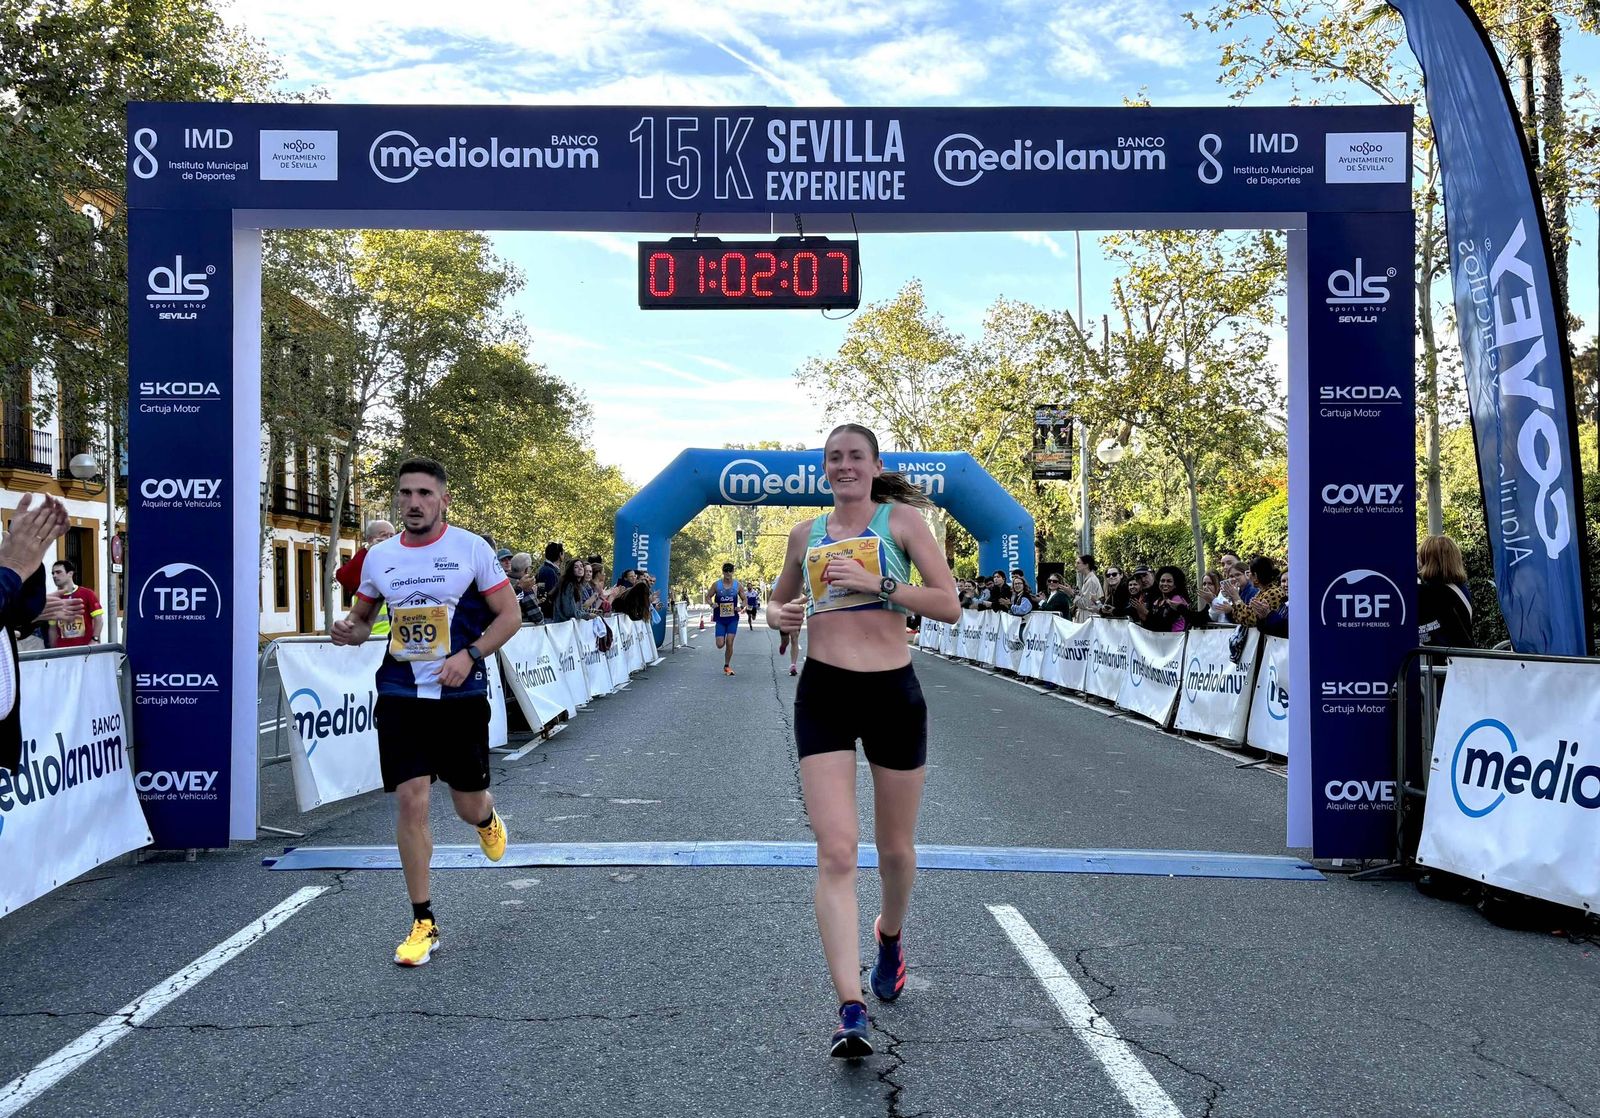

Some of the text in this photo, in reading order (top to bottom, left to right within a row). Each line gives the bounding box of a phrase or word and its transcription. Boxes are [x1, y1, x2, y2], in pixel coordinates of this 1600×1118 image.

[184, 128, 233, 148] IMD
[551, 135, 598, 146] BANCO
[767, 119, 905, 163] SEVILLA
[1117, 136, 1165, 148] BANCO
[1249, 133, 1299, 153] IMD
[380, 137, 599, 168] mediolanum
[945, 139, 1166, 171] mediolanum
[168, 161, 249, 171] Instituto Municipal
[1233, 166, 1314, 175] Instituto Municipal
[182, 172, 236, 181] de Deportes
[1246, 176, 1301, 186] de Deportes
[767, 171, 905, 200] EXPERIENCE
[159, 312, 197, 320] SEVILLA
[1338, 315, 1378, 323] SEVILLA
[140, 404, 200, 414] Cartuja Motor
[1320, 408, 1382, 419] Cartuja Motor
[898, 462, 946, 471] BANCO
[140, 479, 222, 499] COVEY
[1321, 484, 1404, 505] COVEY
[141, 500, 221, 509] Alquiler de Vehículos
[1322, 505, 1404, 515] Alquiler de Vehículos
[392, 577, 445, 587] mediolanum
[153, 587, 207, 611] TBF
[1335, 594, 1391, 618] TBF
[399, 624, 437, 643] 959
[136, 695, 198, 706] Cartuja Motor
[1322, 704, 1386, 715] Cartuja Motor
[92, 714, 121, 736] BANCO
[134, 771, 219, 791] COVEY
[138, 793, 166, 802] lquiler
[179, 792, 218, 800] Vehículos
[1325, 802, 1356, 812] Alquiler
[1358, 802, 1369, 810] de
